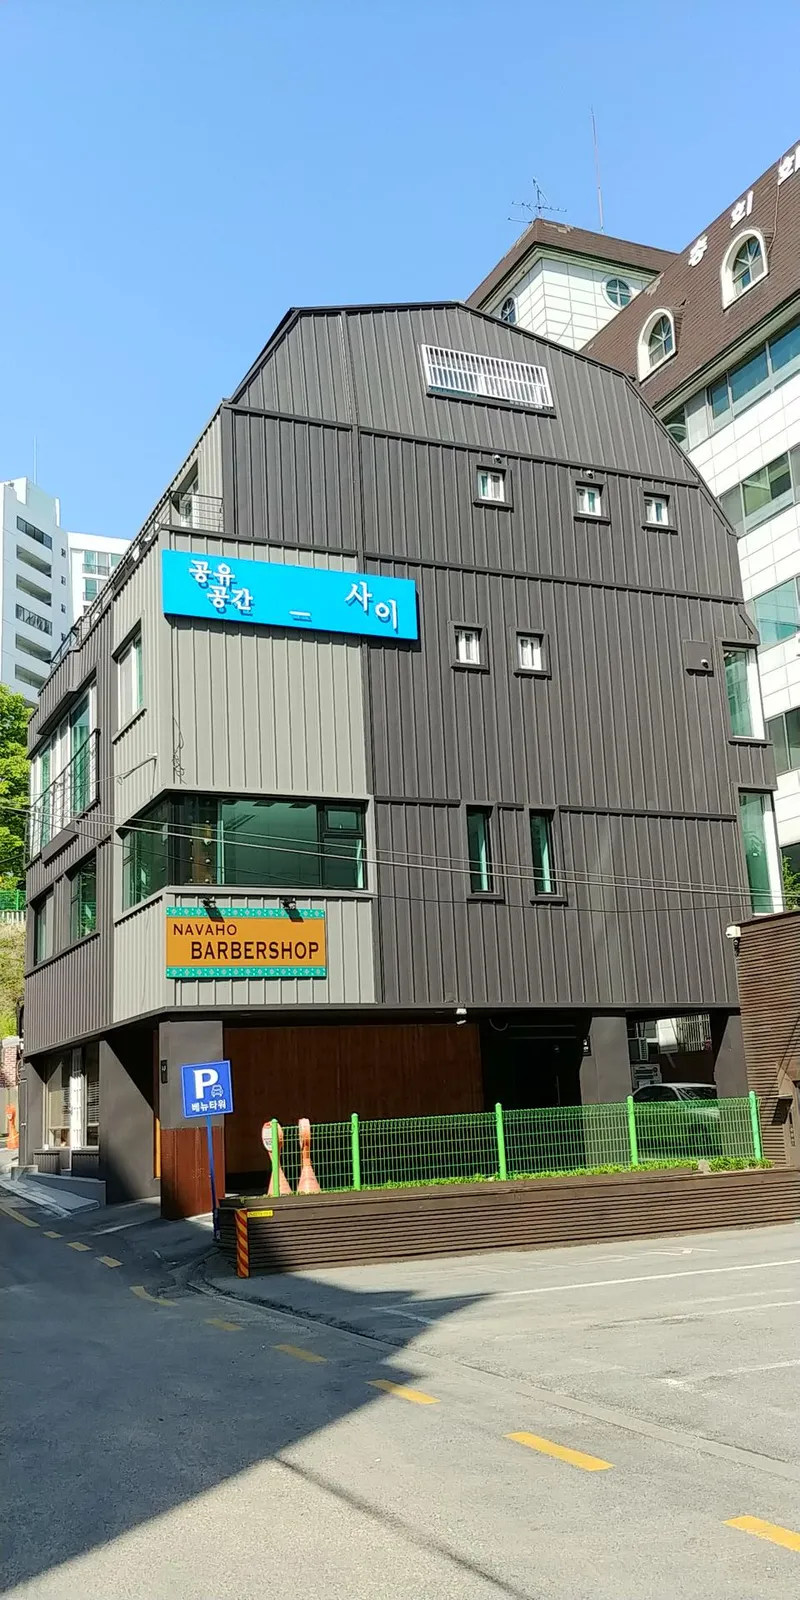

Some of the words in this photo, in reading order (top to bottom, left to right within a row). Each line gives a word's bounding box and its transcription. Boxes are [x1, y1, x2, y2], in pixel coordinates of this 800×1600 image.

[188, 559, 236, 584] 공유
[206, 585, 254, 611] 공간
[344, 581, 399, 630] 사이
[173, 923, 237, 936] NAVAHO
[191, 941, 319, 960] BARBERSHOP
[192, 1068, 219, 1100] P
